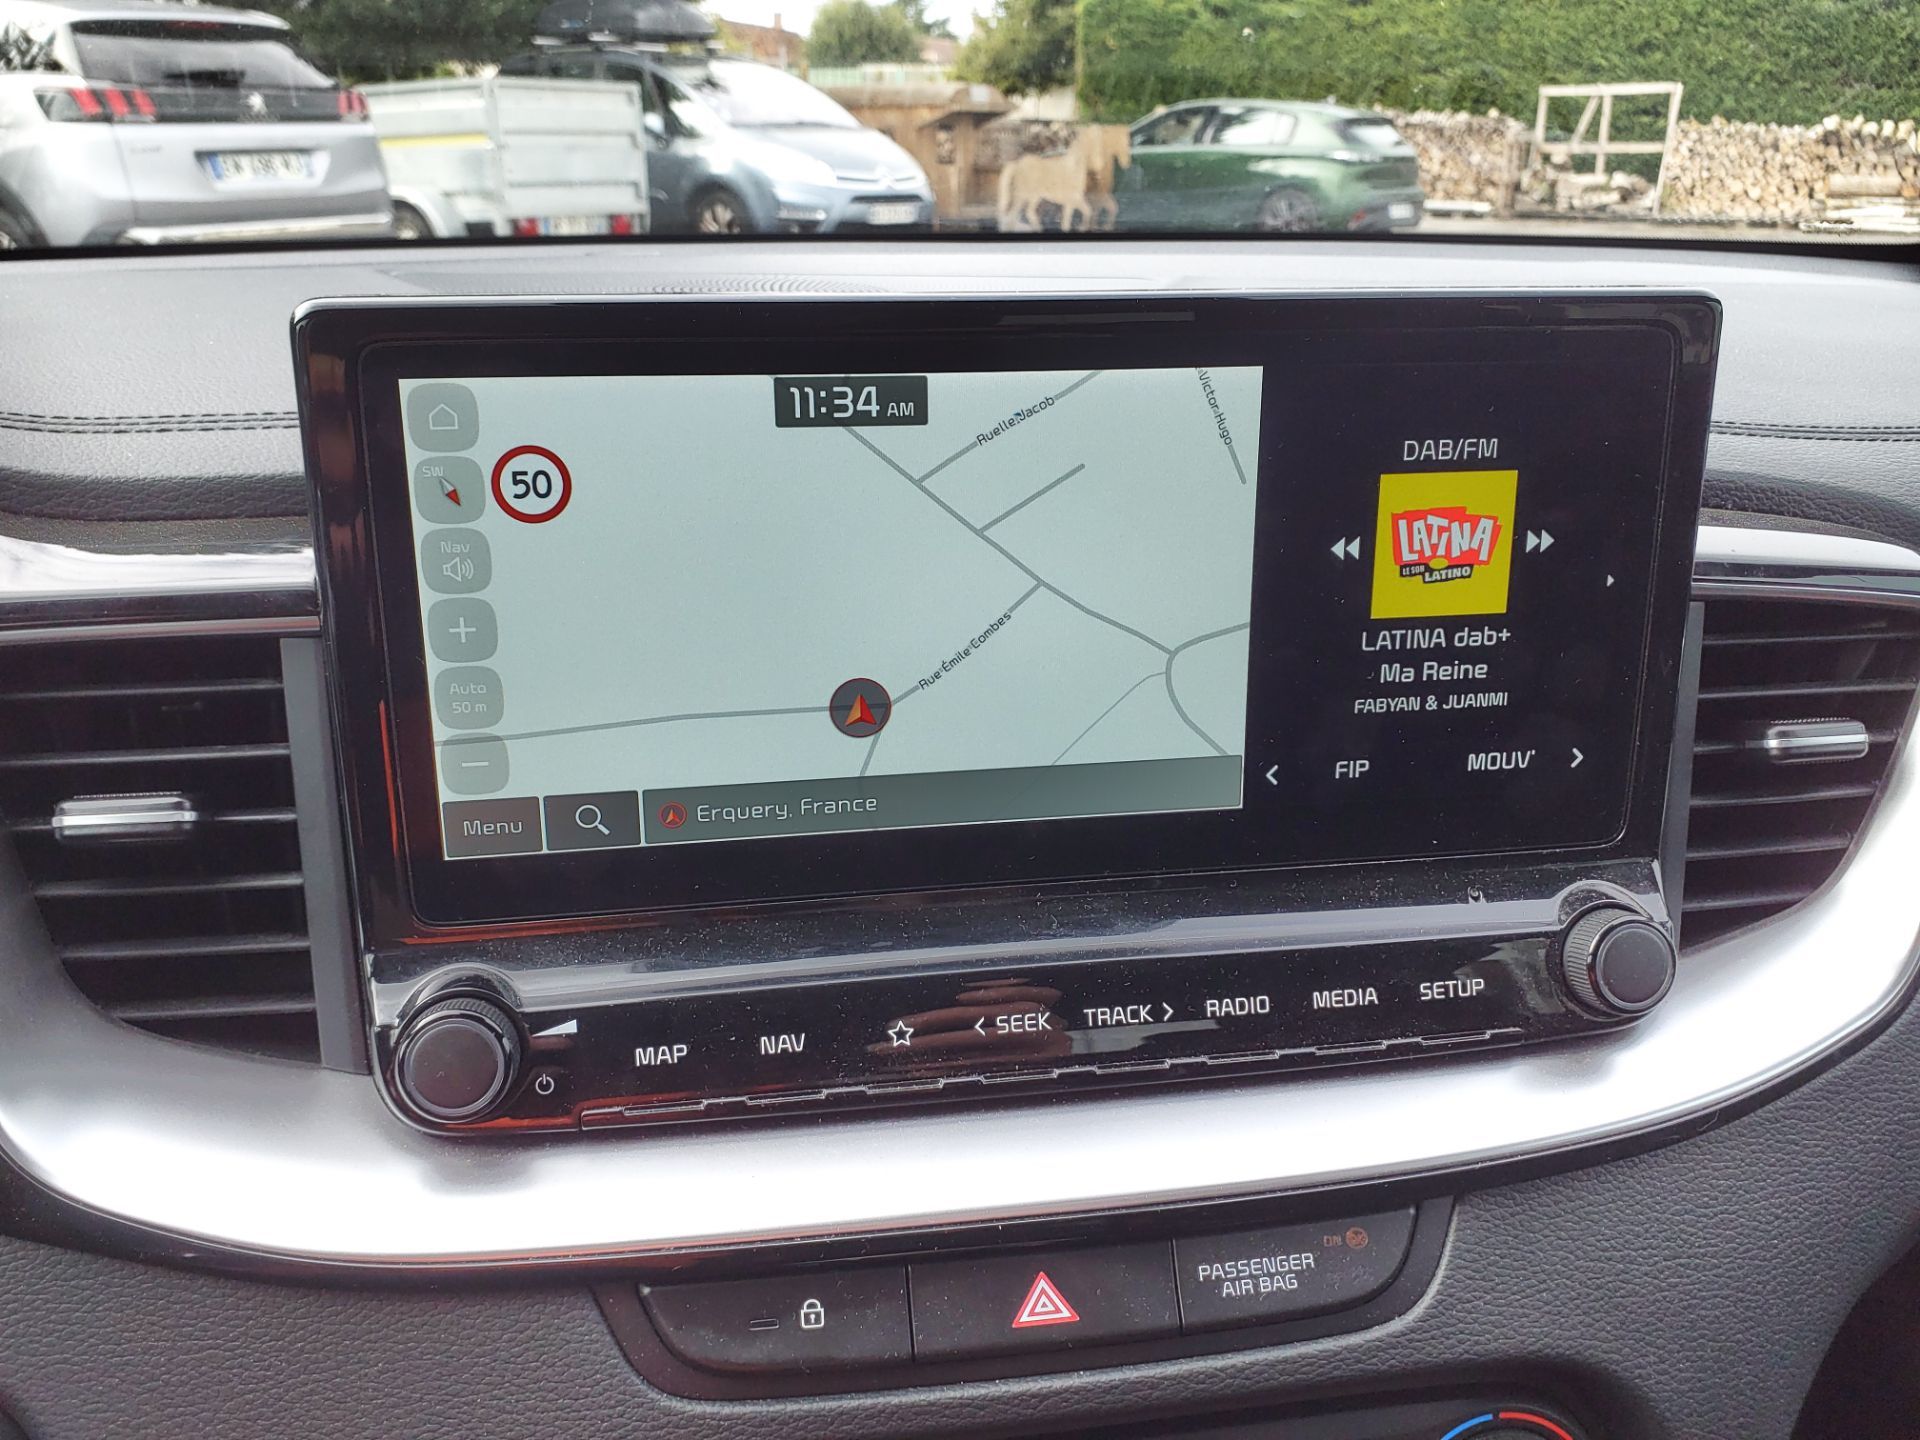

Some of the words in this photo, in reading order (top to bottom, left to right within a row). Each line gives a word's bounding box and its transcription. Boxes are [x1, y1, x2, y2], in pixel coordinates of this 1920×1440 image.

[789, 385, 881, 419] 11:34
[886, 401, 915, 418] AM
[1199, 370, 1220, 410] Victor
[1214, 412, 1233, 446] Hugo
[976, 417, 1016, 446] Ruelle
[1018, 396, 1055, 421] Jacob
[1403, 438, 1499, 461] DAB/FM
[422, 466, 444, 478] SW
[511, 469, 552, 500] 50
[440, 541, 471, 554] Nav
[1397, 514, 1494, 562] LATINA
[1402, 566, 1410, 576] LE
[1424, 566, 1471, 582] LATINO
[1361, 628, 1446, 652] LATINA
[1454, 626, 1511, 648] dab+
[918, 671, 942, 691] Rue
[941, 651, 972, 673] Émile
[970, 612, 1012, 649] Combes
[1380, 664, 1414, 683] Ma
[1423, 661, 1488, 681] Reine
[449, 681, 487, 696] Auto
[452, 702, 471, 714] 50
[474, 704, 487, 713] m
[1353, 696, 1421, 715] FABYAN
[1425, 697, 1438, 710] &
[1442, 692, 1509, 710] JUANMI
[1334, 759, 1370, 779] FIP
[1467, 749, 1536, 772] MOUV'
[800, 795, 878, 816] France
[463, 818, 523, 837] Menu
[1312, 987, 1379, 1010] MEDIA
[1419, 978, 1486, 1001] SETUP
[1083, 1004, 1153, 1028] TRACK
[1206, 995, 1270, 1019] RADIO
[996, 1012, 1052, 1035] SEEK
[635, 1043, 689, 1067] MAP
[760, 1032, 806, 1056] NAV
[1198, 1252, 1316, 1282] PASSENGER
[1222, 1279, 1255, 1298] AIR
[1259, 1273, 1299, 1293] BAG
